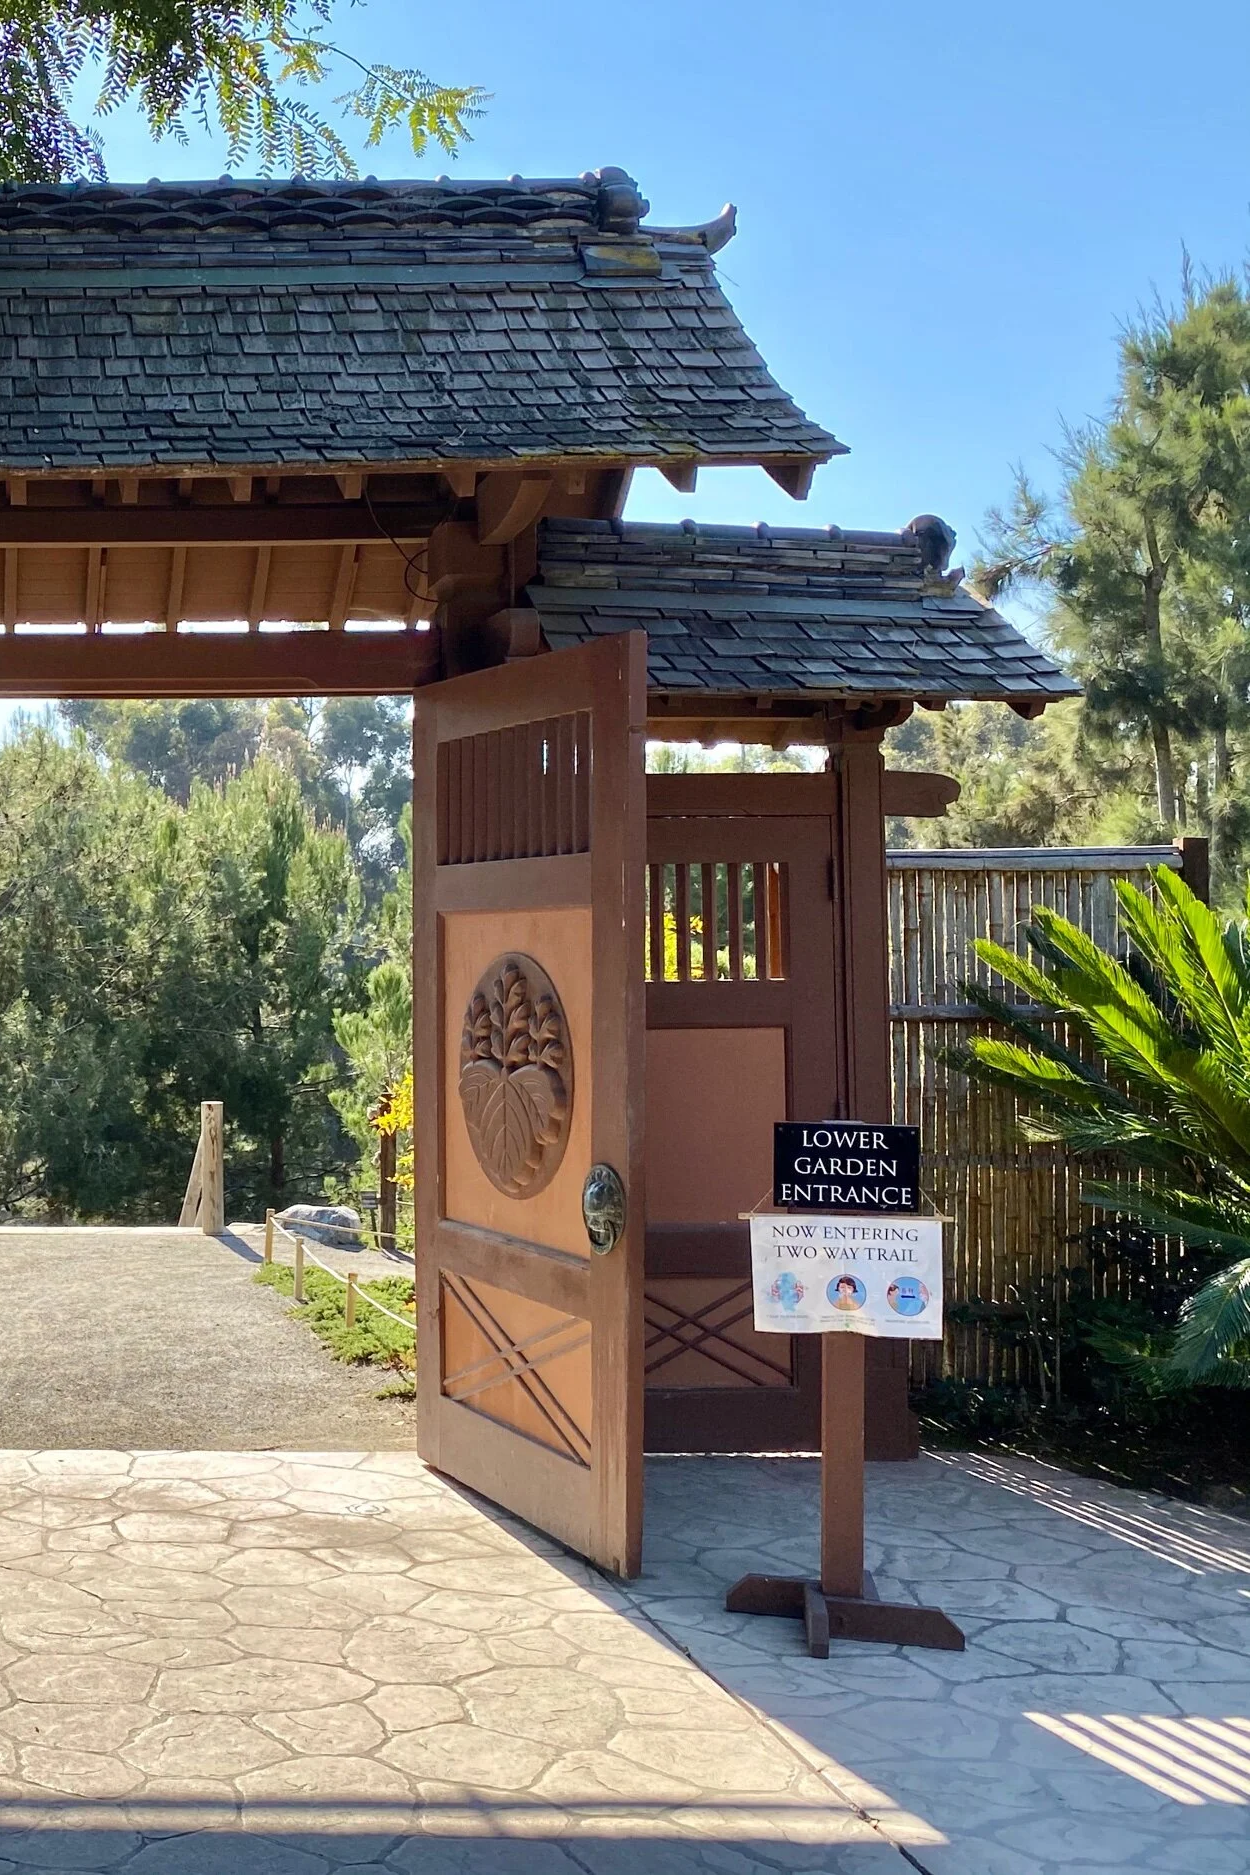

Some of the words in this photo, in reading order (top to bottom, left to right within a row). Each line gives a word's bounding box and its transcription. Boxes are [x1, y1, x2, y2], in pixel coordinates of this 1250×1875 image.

[803, 1130, 889, 1149] LOWER
[794, 1157, 897, 1177] GARDEN
[782, 1184, 912, 1205] ENTRANCE
[772, 1226, 816, 1238] NOW
[823, 1227, 918, 1241] ENTERING
[773, 1245, 817, 1259] TWO
[823, 1247, 860, 1260] WAY
[864, 1248, 918, 1262] TRAIL
